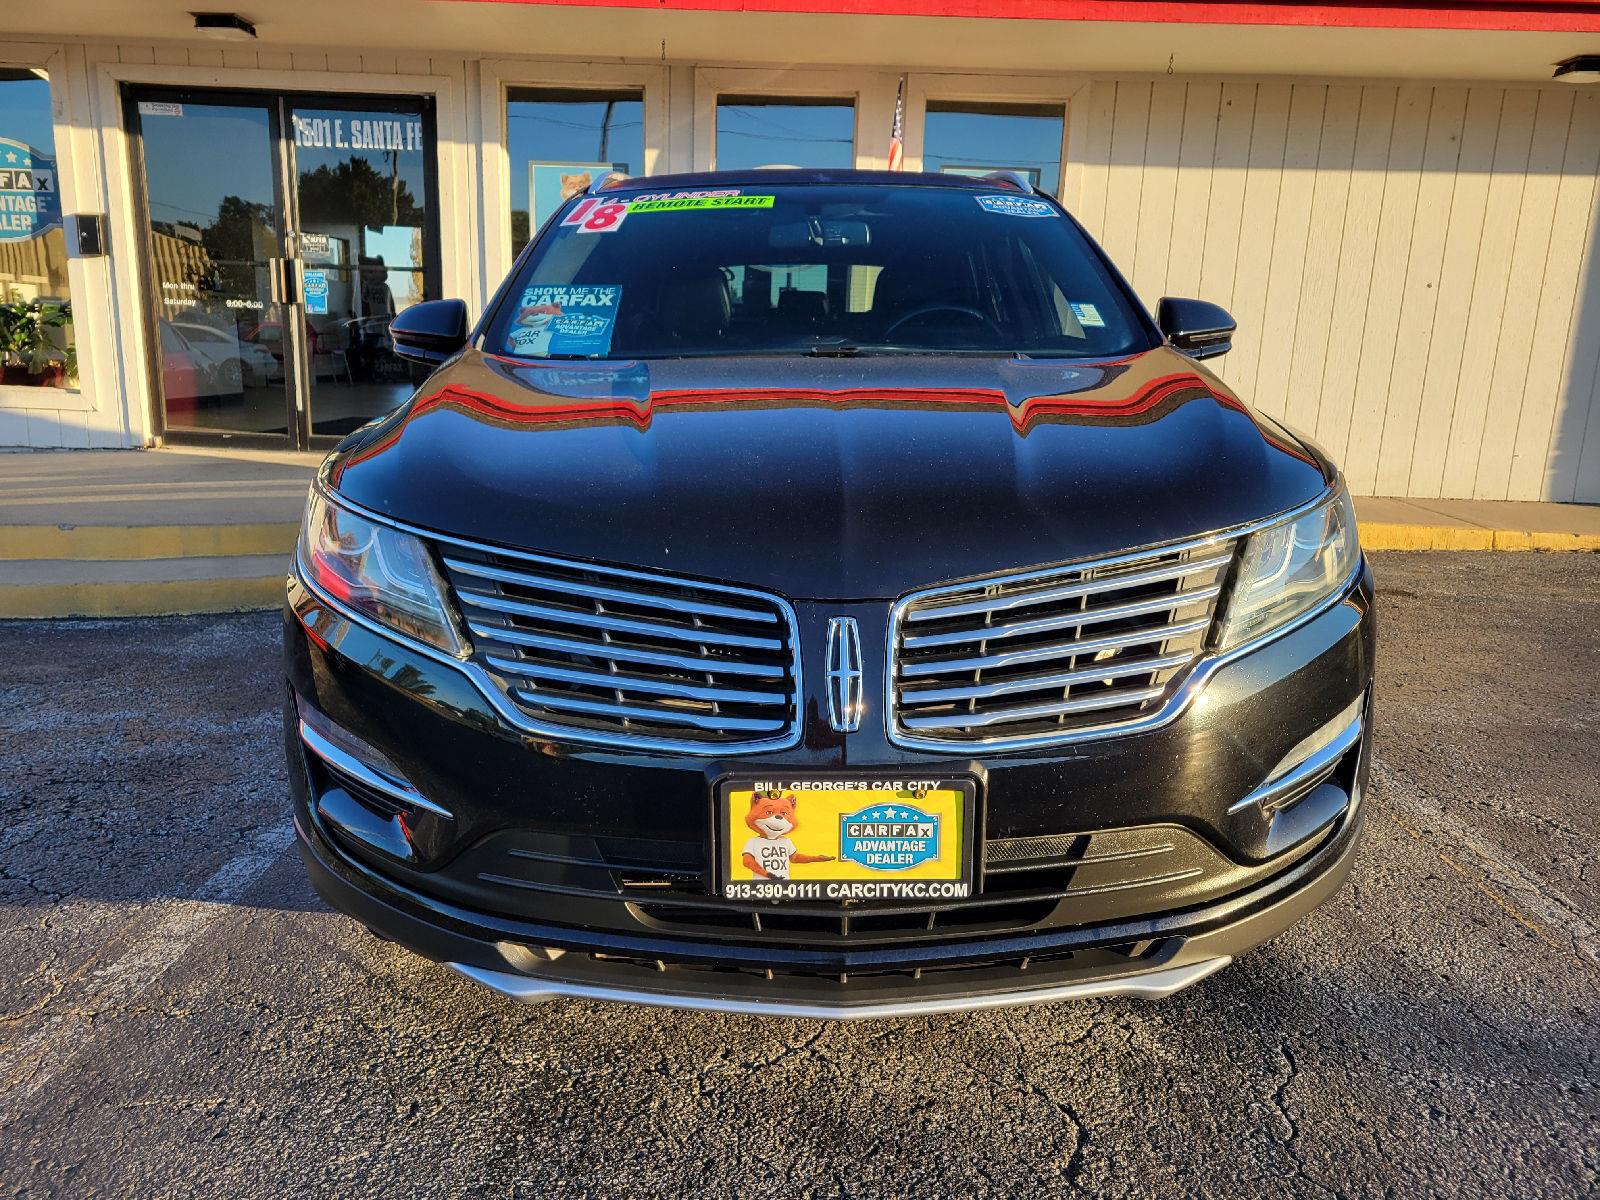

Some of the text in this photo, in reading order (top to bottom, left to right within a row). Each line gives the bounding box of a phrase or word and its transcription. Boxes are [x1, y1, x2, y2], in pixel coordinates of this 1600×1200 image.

[294, 118, 423, 151] 1501 E. SANTA FE
[632, 197, 770, 211] REMOTE START
[566, 199, 627, 230] 18
[0, 213, 32, 231] LER
[162, 281, 195, 290] Mon thru
[523, 287, 616, 296] SHOW ME THE
[164, 298, 196, 307] Saturday
[520, 294, 614, 307] CARFAX
[555, 324, 598, 332] ADVANTAGE
[754, 781, 941, 791] BILL GEORGE'S CAR CITY
[849, 824, 931, 838] CARFAX
[761, 846, 788, 858] CAR
[853, 840, 926, 852] ADVANTAGE
[866, 853, 914, 864] DEALER
[762, 859, 788, 871] FOX
[725, 883, 968, 898] 913-390-0111 CARCITYKC.COM
